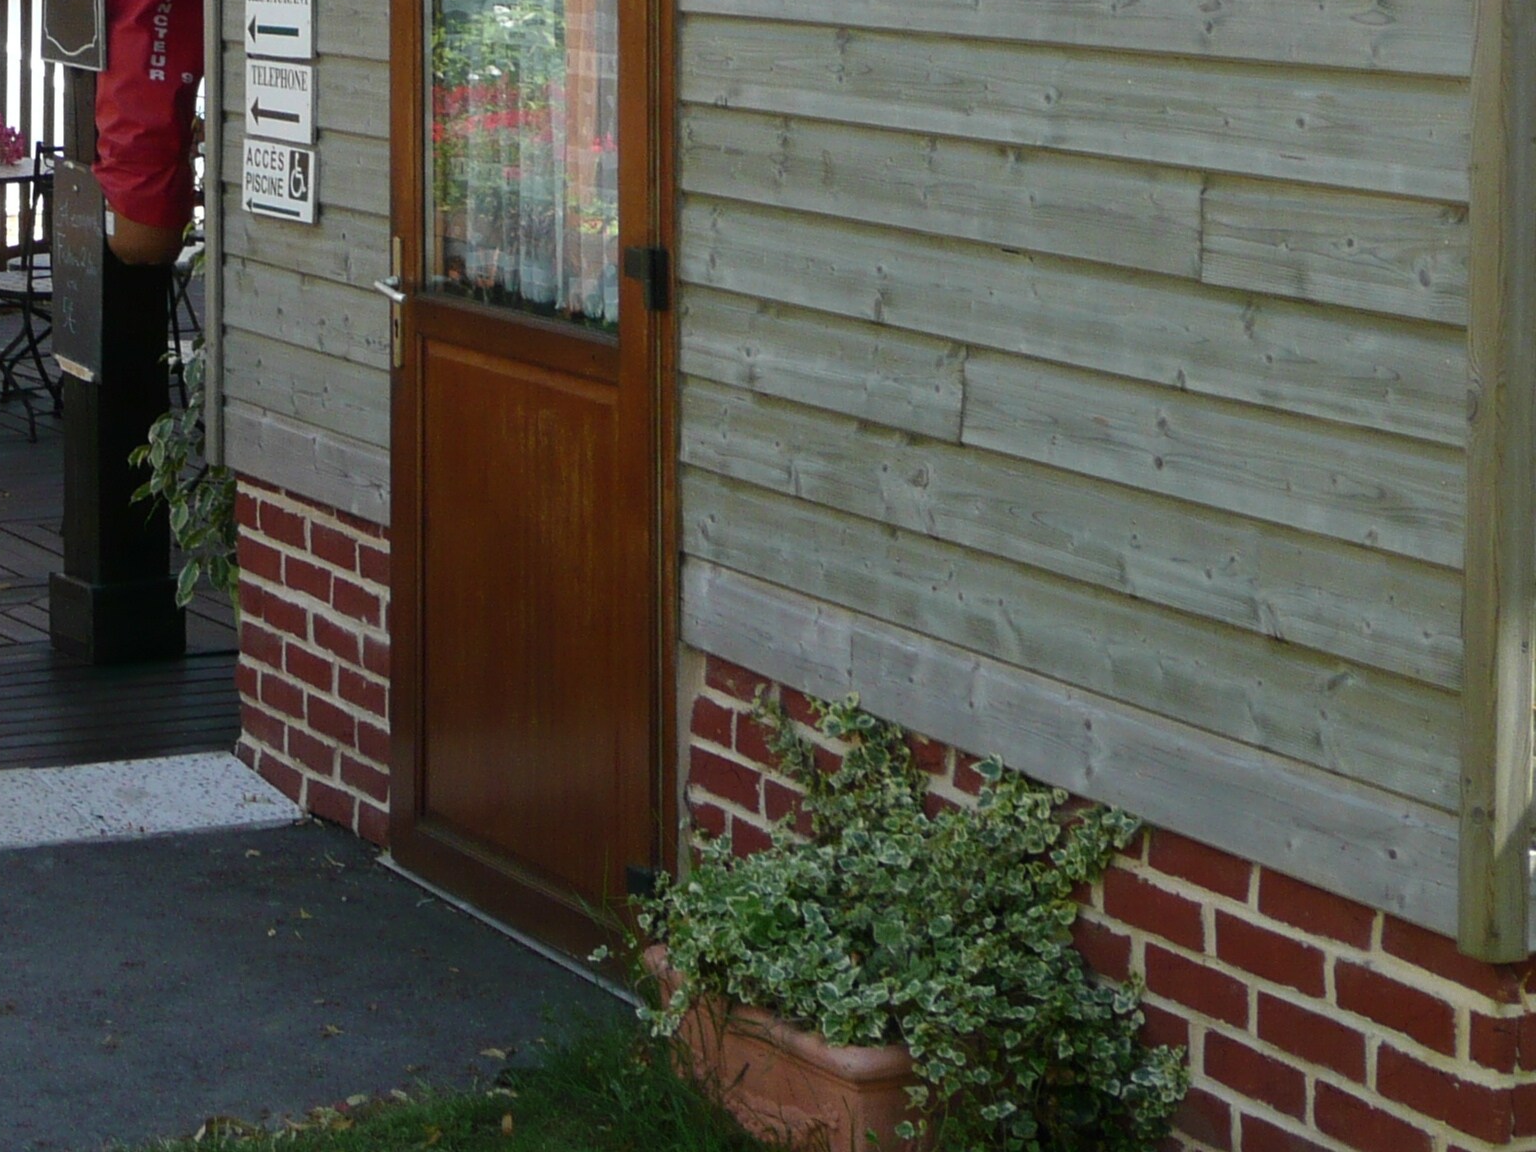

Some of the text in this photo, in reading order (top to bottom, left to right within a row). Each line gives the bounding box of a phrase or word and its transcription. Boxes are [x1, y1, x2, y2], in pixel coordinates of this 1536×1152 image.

[251, 64, 308, 92] TELEPHONE
[246, 145, 285, 171] ACCÈS
[245, 171, 284, 198] PISCINE
